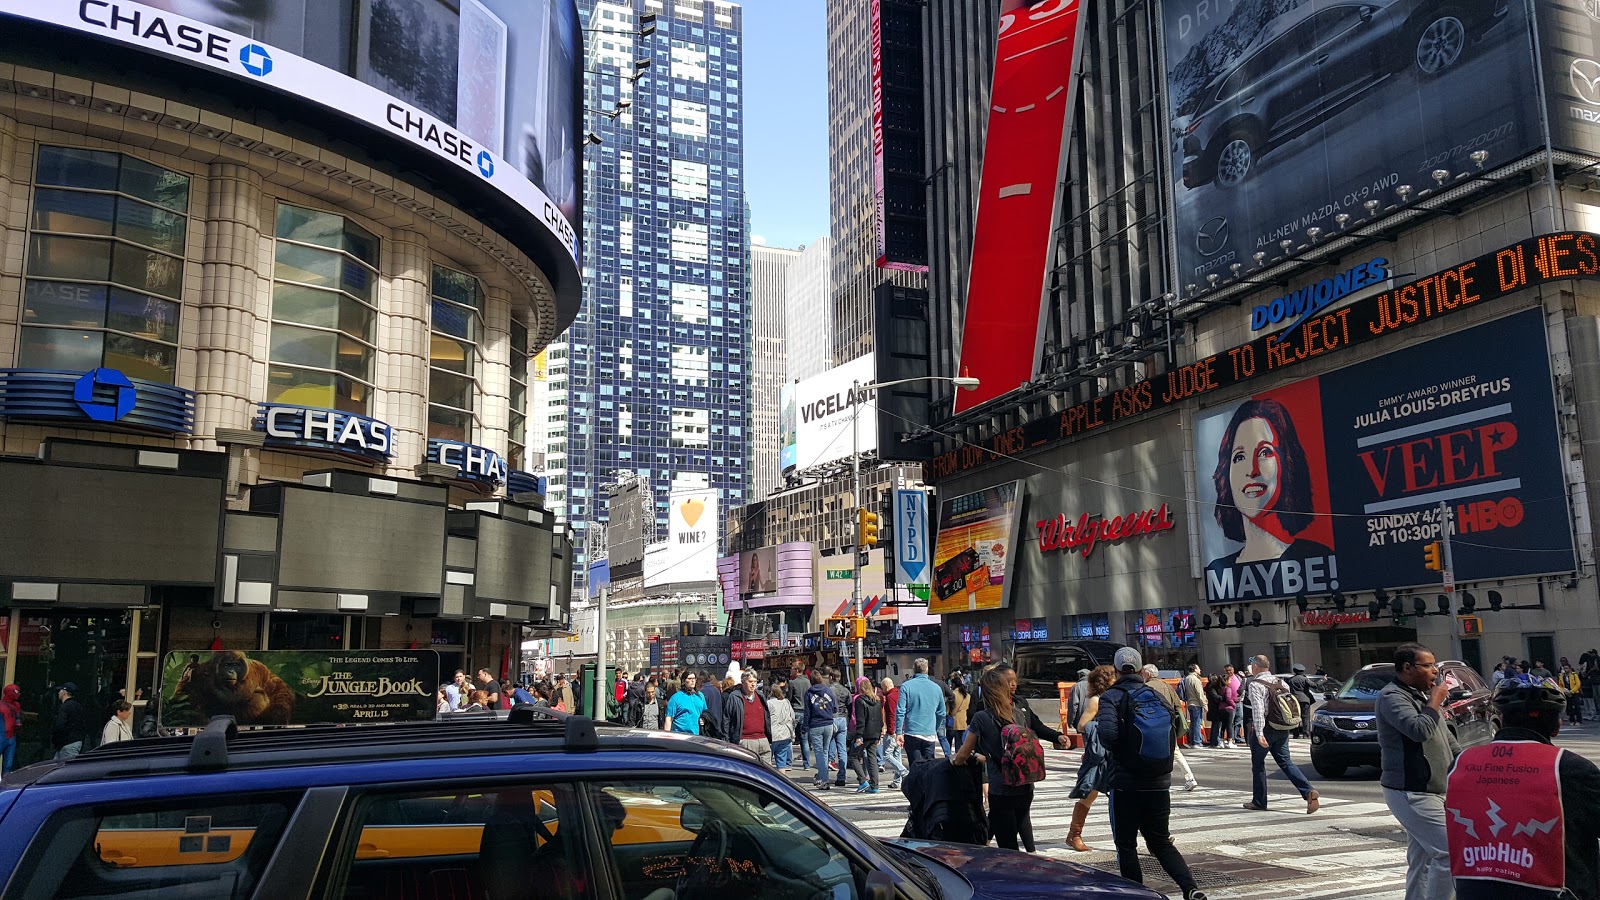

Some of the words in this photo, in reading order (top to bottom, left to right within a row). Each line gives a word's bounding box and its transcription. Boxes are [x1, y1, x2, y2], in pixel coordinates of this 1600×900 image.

[79, 0, 231, 63] CHASE
[872, 77, 882, 116] FOR
[387, 103, 473, 166] CHASE
[1256, 219, 1299, 248] ALL-NEW
[1302, 201, 1341, 227] MAZDA
[1343, 186, 1369, 207] CX-9
[1372, 173, 1399, 194] AWD
[543, 201, 575, 250] CHASE
[1194, 250, 1235, 276] mazda
[932, 451, 958, 480] FROM
[1060, 397, 1105, 438] APPLE
[1112, 380, 1153, 421] ASKS
[1162, 356, 1219, 403] JUDGE
[1228, 345, 1256, 380] TO
[1266, 307, 1351, 370] REJECT
[1369, 261, 1480, 335] JUSTICE
[1406, 385, 1439, 400] AWARD
[1440, 375, 1477, 391] WINNER
[1354, 409, 1391, 429] JULIA
[1393, 377, 1511, 419] LOUIS-DREYFUS
[1357, 421, 1518, 497] VEEP
[905, 494, 918, 561] NYPD
[1366, 512, 1420, 532] SUNDAY
[1457, 496, 1524, 534] HBO
[1035, 502, 1174, 558] Walgreens
[1369, 532, 1387, 547] AT
[829, 570, 835, 579] W
[835, 570, 843, 579] 42
[1206, 555, 1339, 601] MAYBE!
[1301, 610, 1371, 629] Walgreens
[307, 675, 378, 697] JUNGLE
[372, 677, 432, 697] BOOK
[332, 671, 354, 680] THE
[353, 710, 380, 718] APRIL
[1491, 746, 1514, 758] 004
[1464, 764, 1482, 773] Kiku
[1484, 763, 1504, 773] Fine
[1506, 764, 1540, 774] Fusion
[1476, 776, 1521, 786] Japanese
[1463, 842, 1534, 869] grubHub
[1495, 867, 1521, 879] eating
